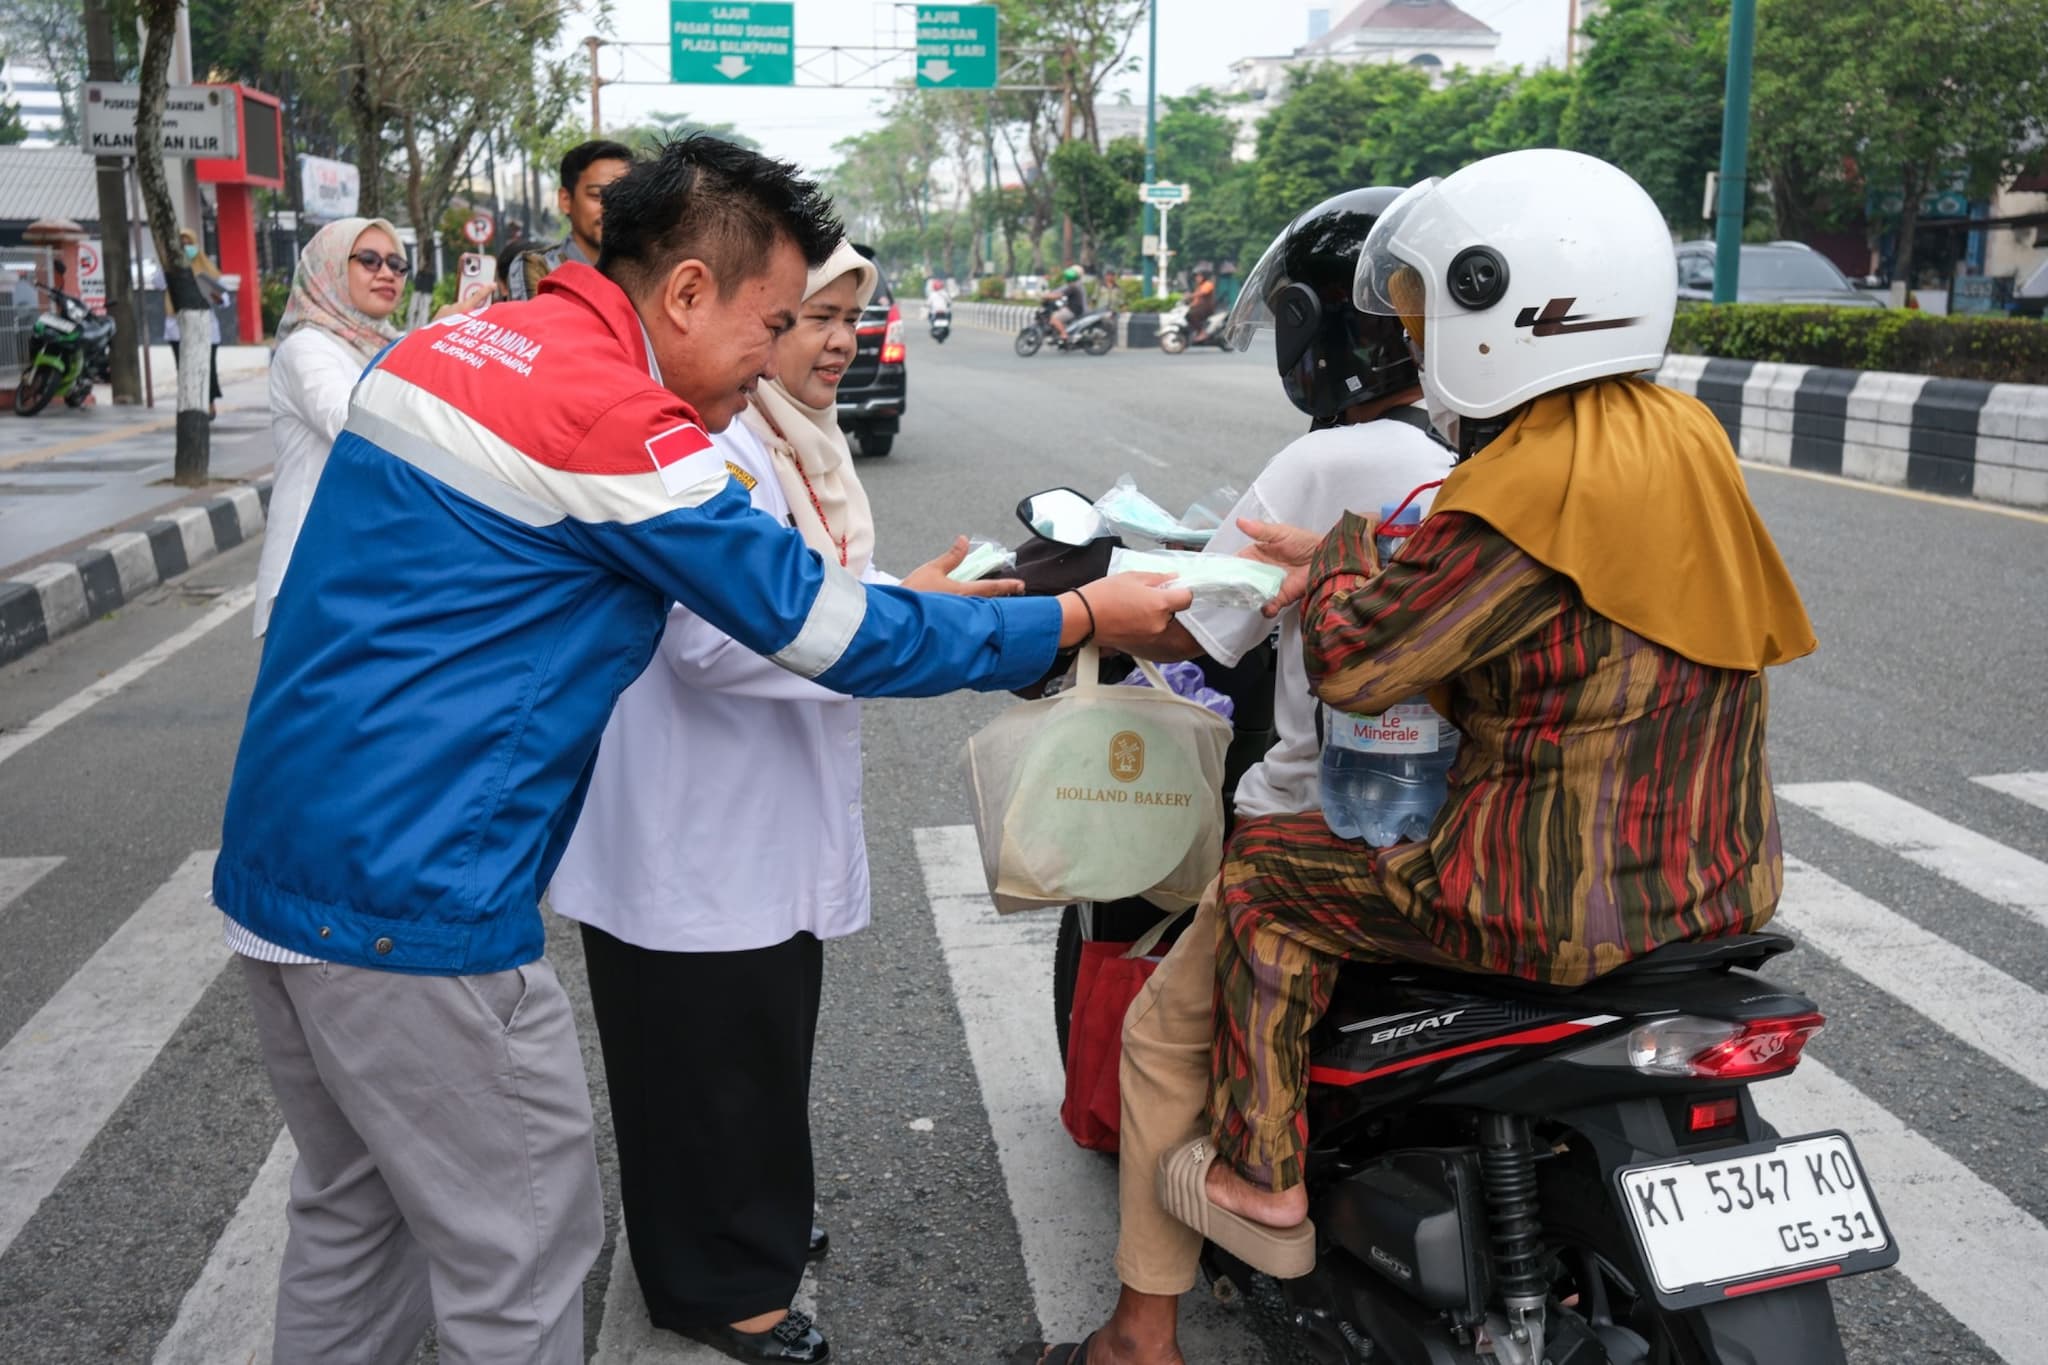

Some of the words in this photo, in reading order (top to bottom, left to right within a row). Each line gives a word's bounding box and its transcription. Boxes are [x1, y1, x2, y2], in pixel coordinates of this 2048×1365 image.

[712, 7, 750, 20] LAJUR
[674, 21, 711, 35] PASAR
[712, 23, 744, 37] BARU
[745, 24, 790, 38] SQUARE
[681, 38, 718, 52] PLAZA
[719, 40, 788, 55] BALIKPAPAN
[953, 44, 986, 57] SARI
[189, 136, 218, 150] ILIR
[456, 319, 542, 363] PERTAMINA
[431, 340, 487, 369] BALIKPAPAN
[475, 343, 533, 377] PERTAMINA
[1381, 711, 1401, 728] Le
[1353, 723, 1419, 741] Minerale
[1056, 786, 1128, 803] HOLLAND
[1134, 791, 1193, 807] BAKERY
[1635, 1177, 1684, 1227] KT
[1705, 1159, 1791, 1214] 5347
[1805, 1150, 1856, 1196] KO
